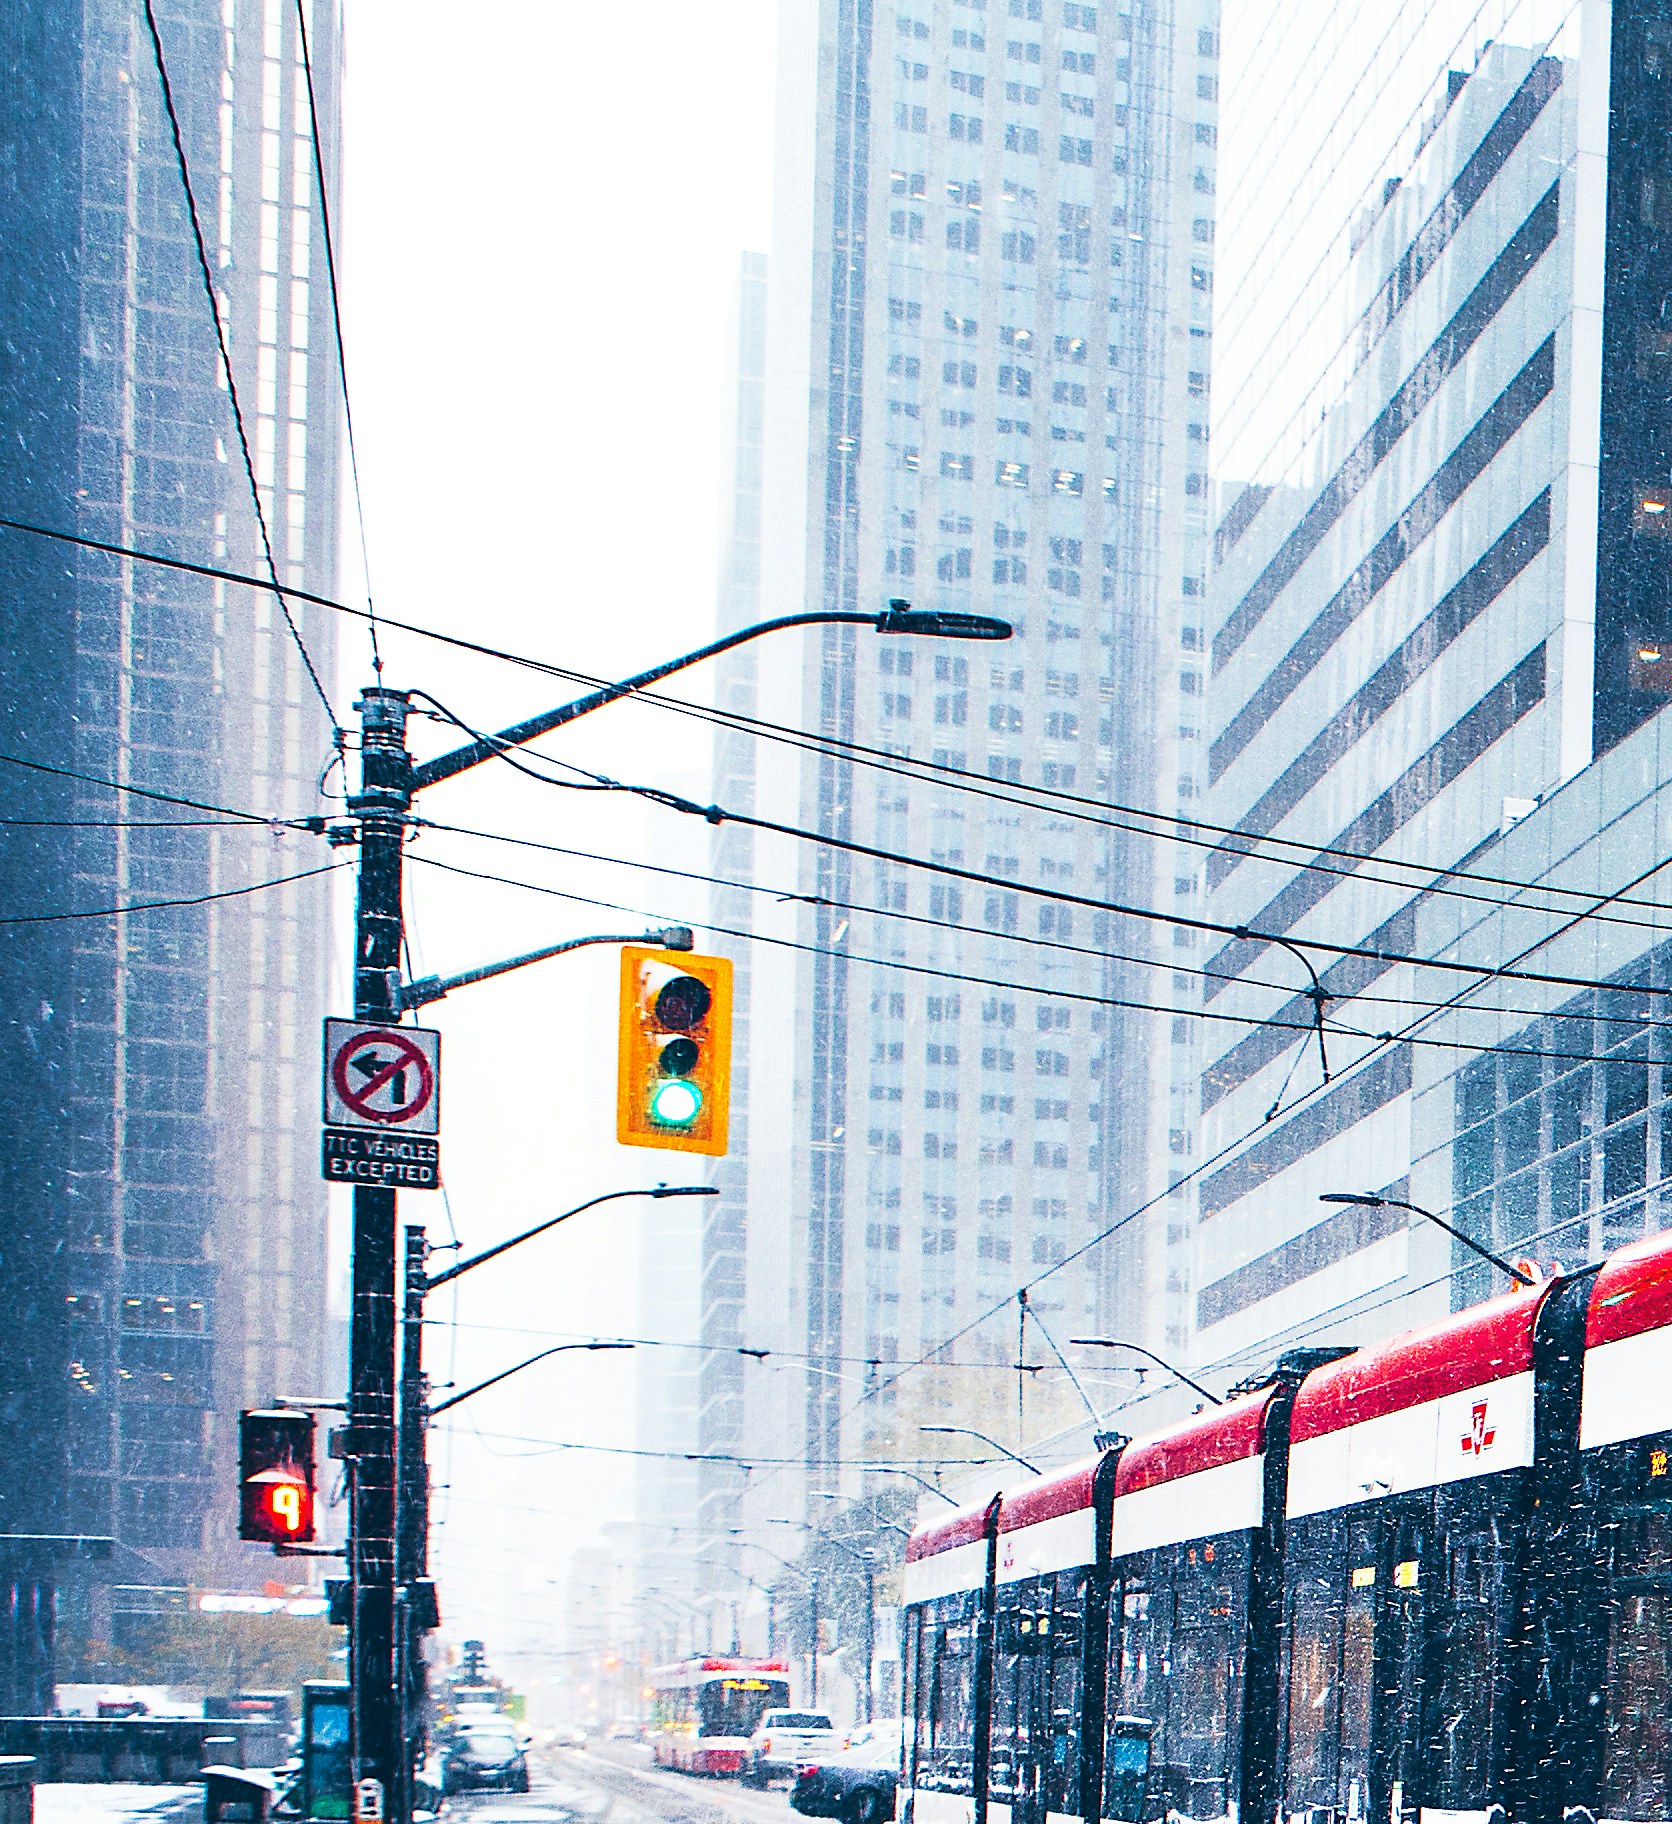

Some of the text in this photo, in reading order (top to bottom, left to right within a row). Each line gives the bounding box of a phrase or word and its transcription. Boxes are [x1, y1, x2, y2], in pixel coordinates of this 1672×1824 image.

[326, 1136, 437, 1162] TTC VEHICLES
[330, 1157, 434, 1182] EXCEPTED
[272, 1484, 300, 1531] 9
